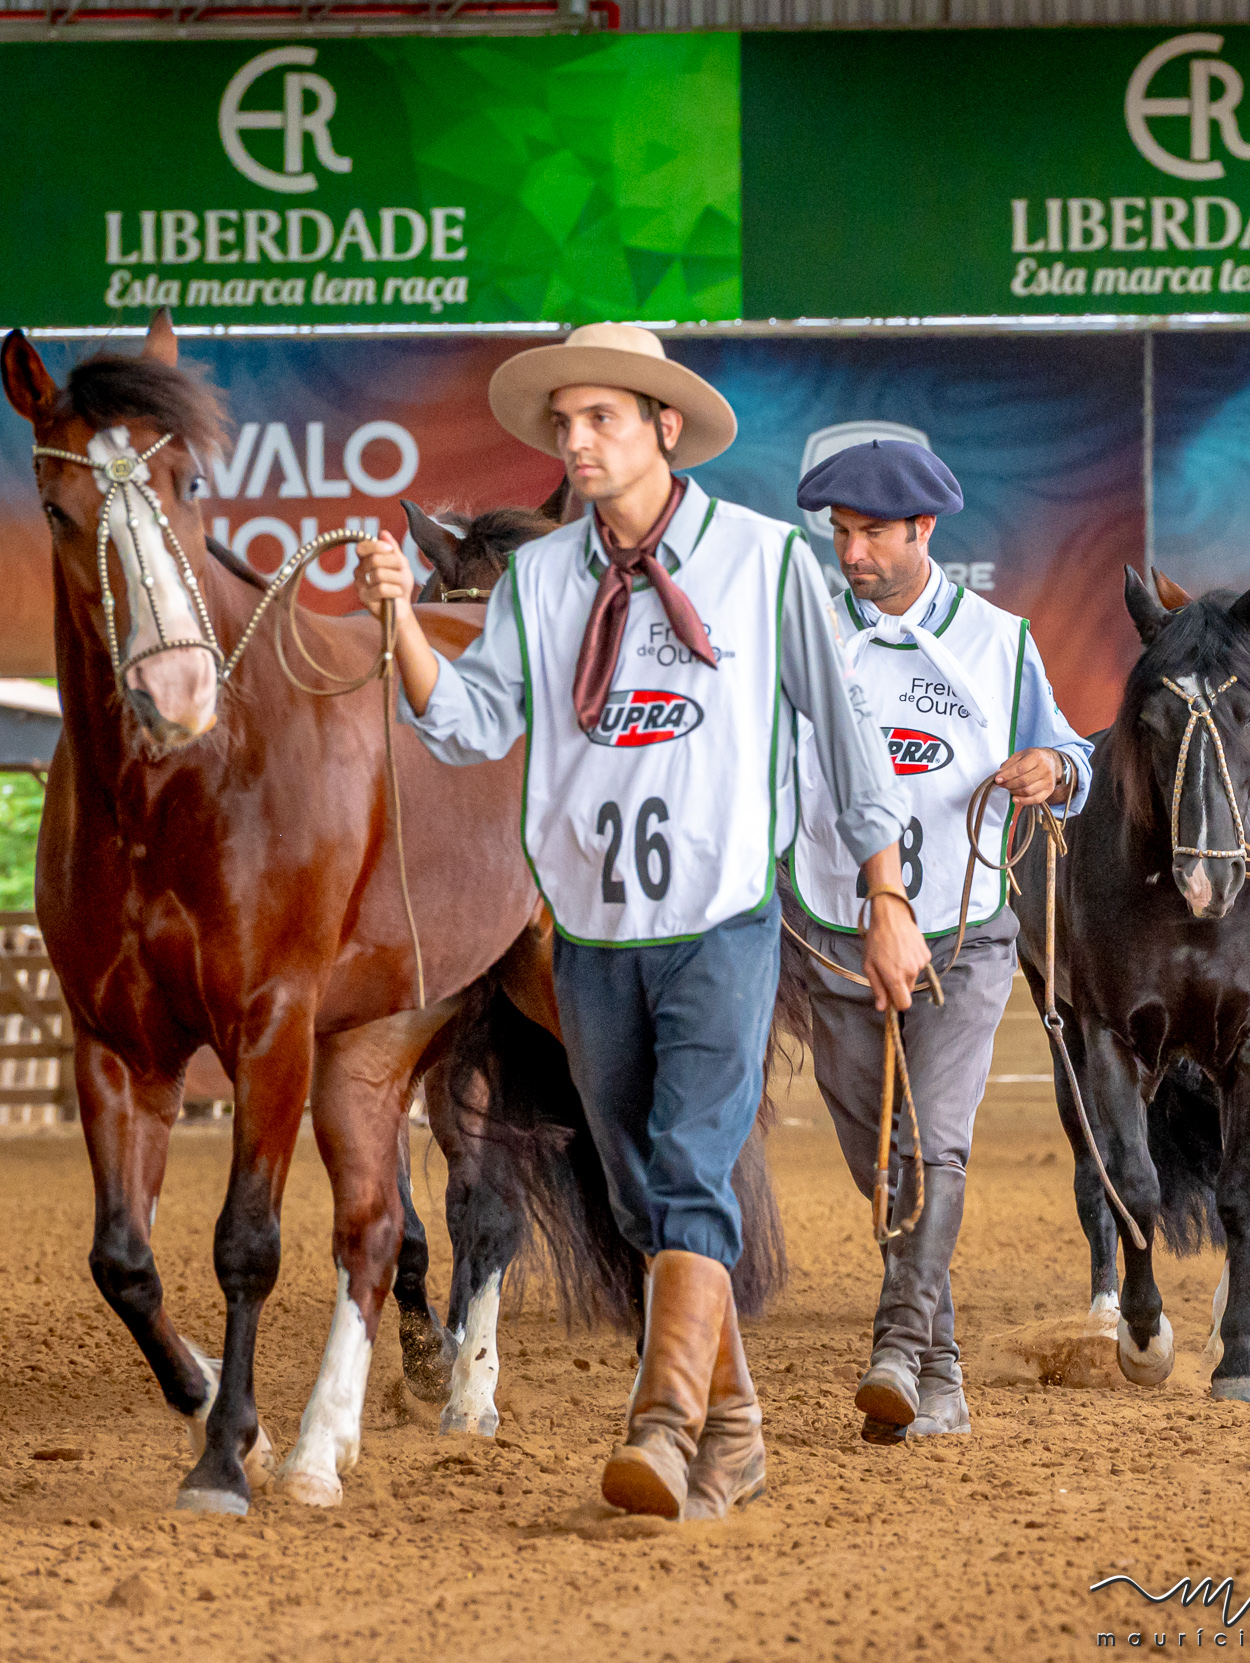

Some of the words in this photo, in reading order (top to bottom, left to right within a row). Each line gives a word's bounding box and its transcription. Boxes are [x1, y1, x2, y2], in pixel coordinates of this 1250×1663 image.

[105, 206, 468, 265] LIBERDADE
[105, 269, 182, 307] Esta
[187, 277, 307, 305] marca
[312, 271, 377, 305] tem
[384, 275, 468, 314] raça
[1011, 257, 1088, 296] Esta
[1092, 265, 1213, 295] marca
[199, 420, 419, 498] VALO
[637, 644, 655, 657] de
[899, 692, 915, 702] de
[911, 677, 958, 699] Frei
[599, 702, 688, 732] UPRA
[887, 740, 941, 763] PRA
[596, 796, 671, 903] 26
[856, 815, 923, 901] 8
